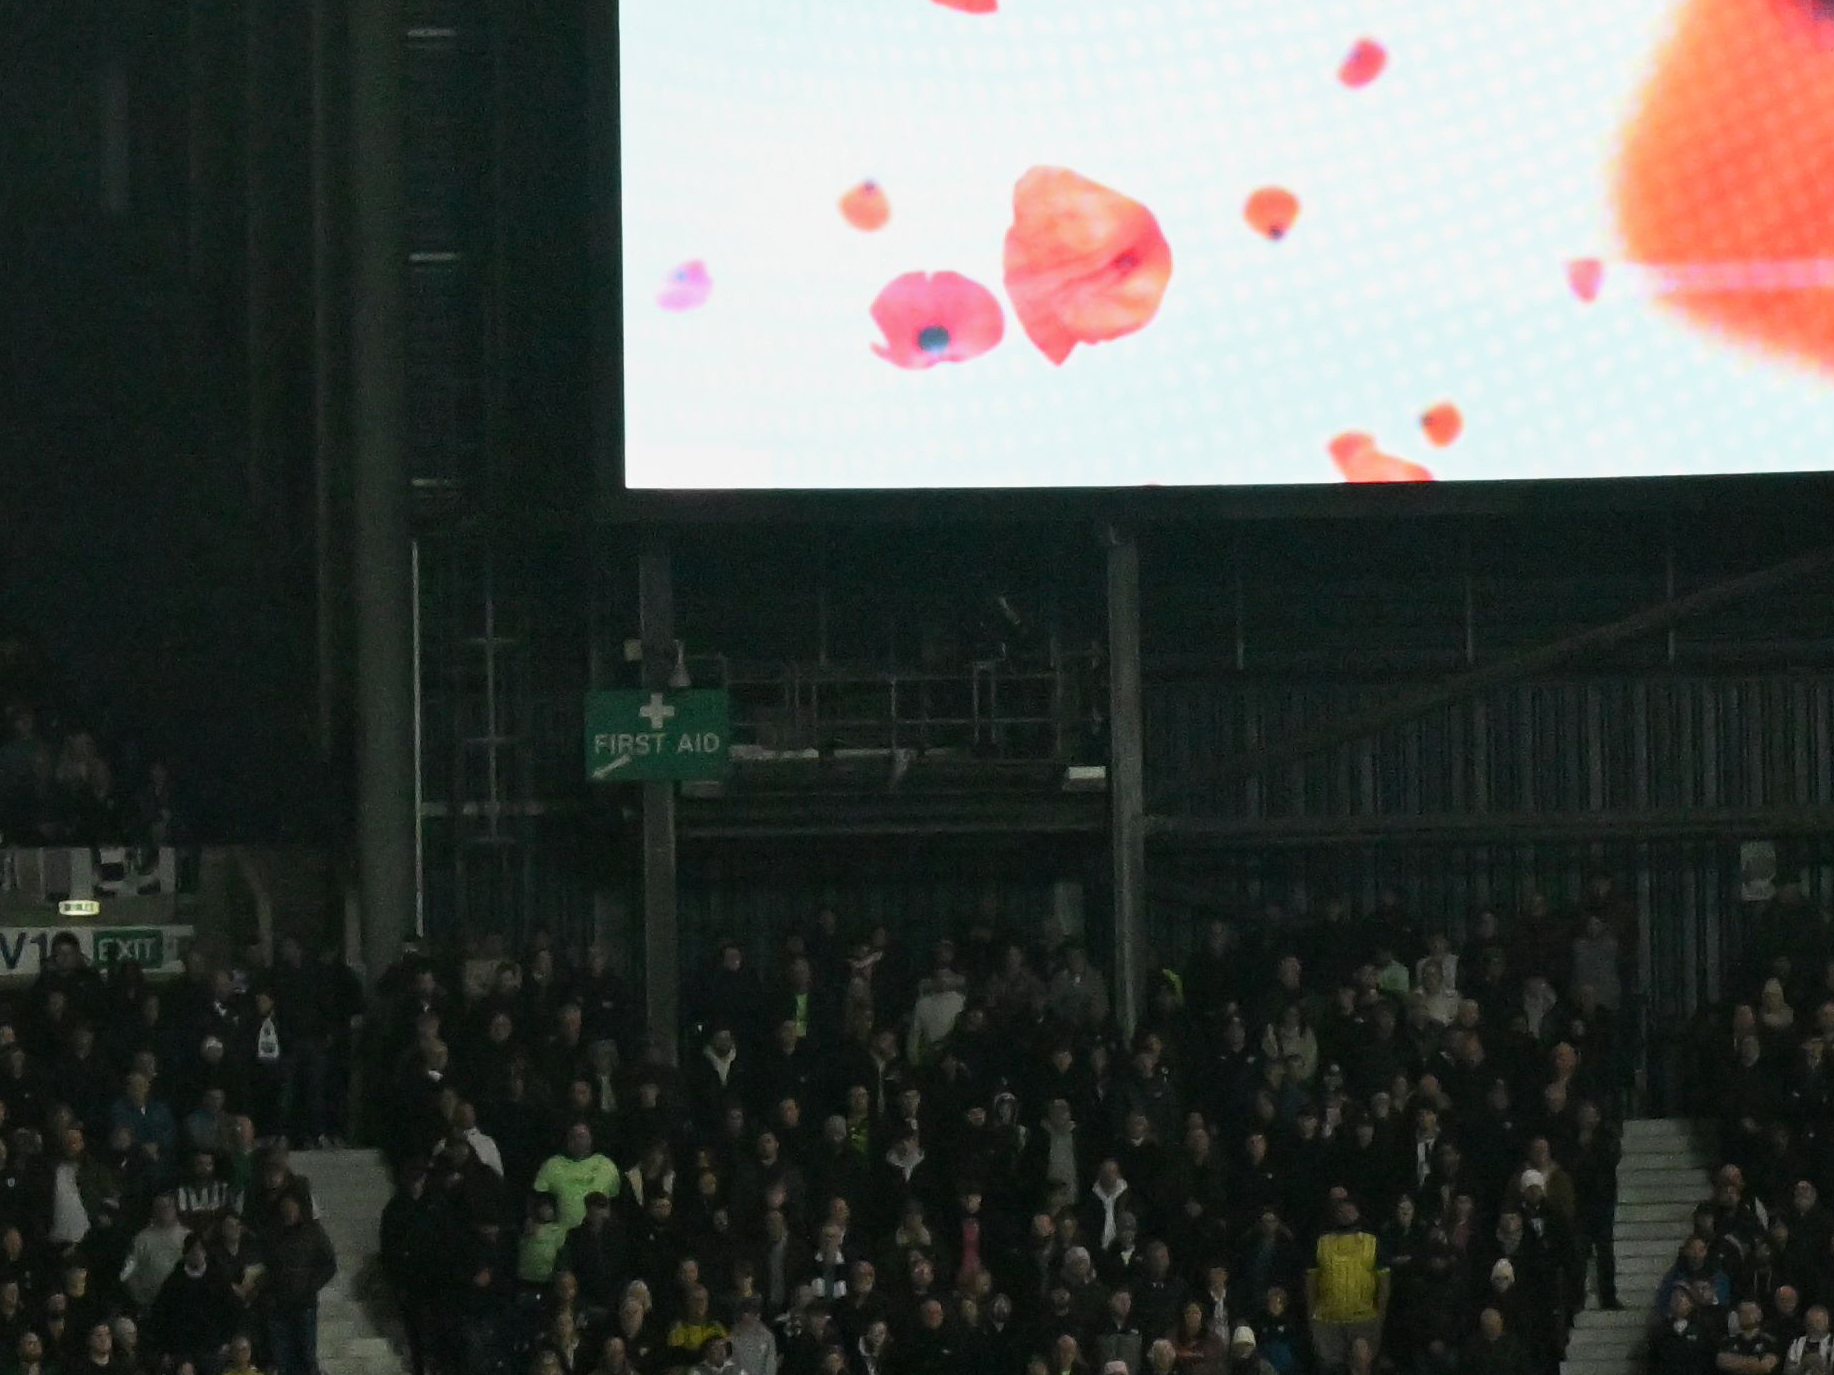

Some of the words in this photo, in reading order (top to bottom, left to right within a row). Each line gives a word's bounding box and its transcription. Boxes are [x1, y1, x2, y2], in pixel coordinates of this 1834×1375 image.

[594, 733, 667, 755] FIRST
[677, 732, 720, 754] AID
[98, 936, 157, 962] EXIT
